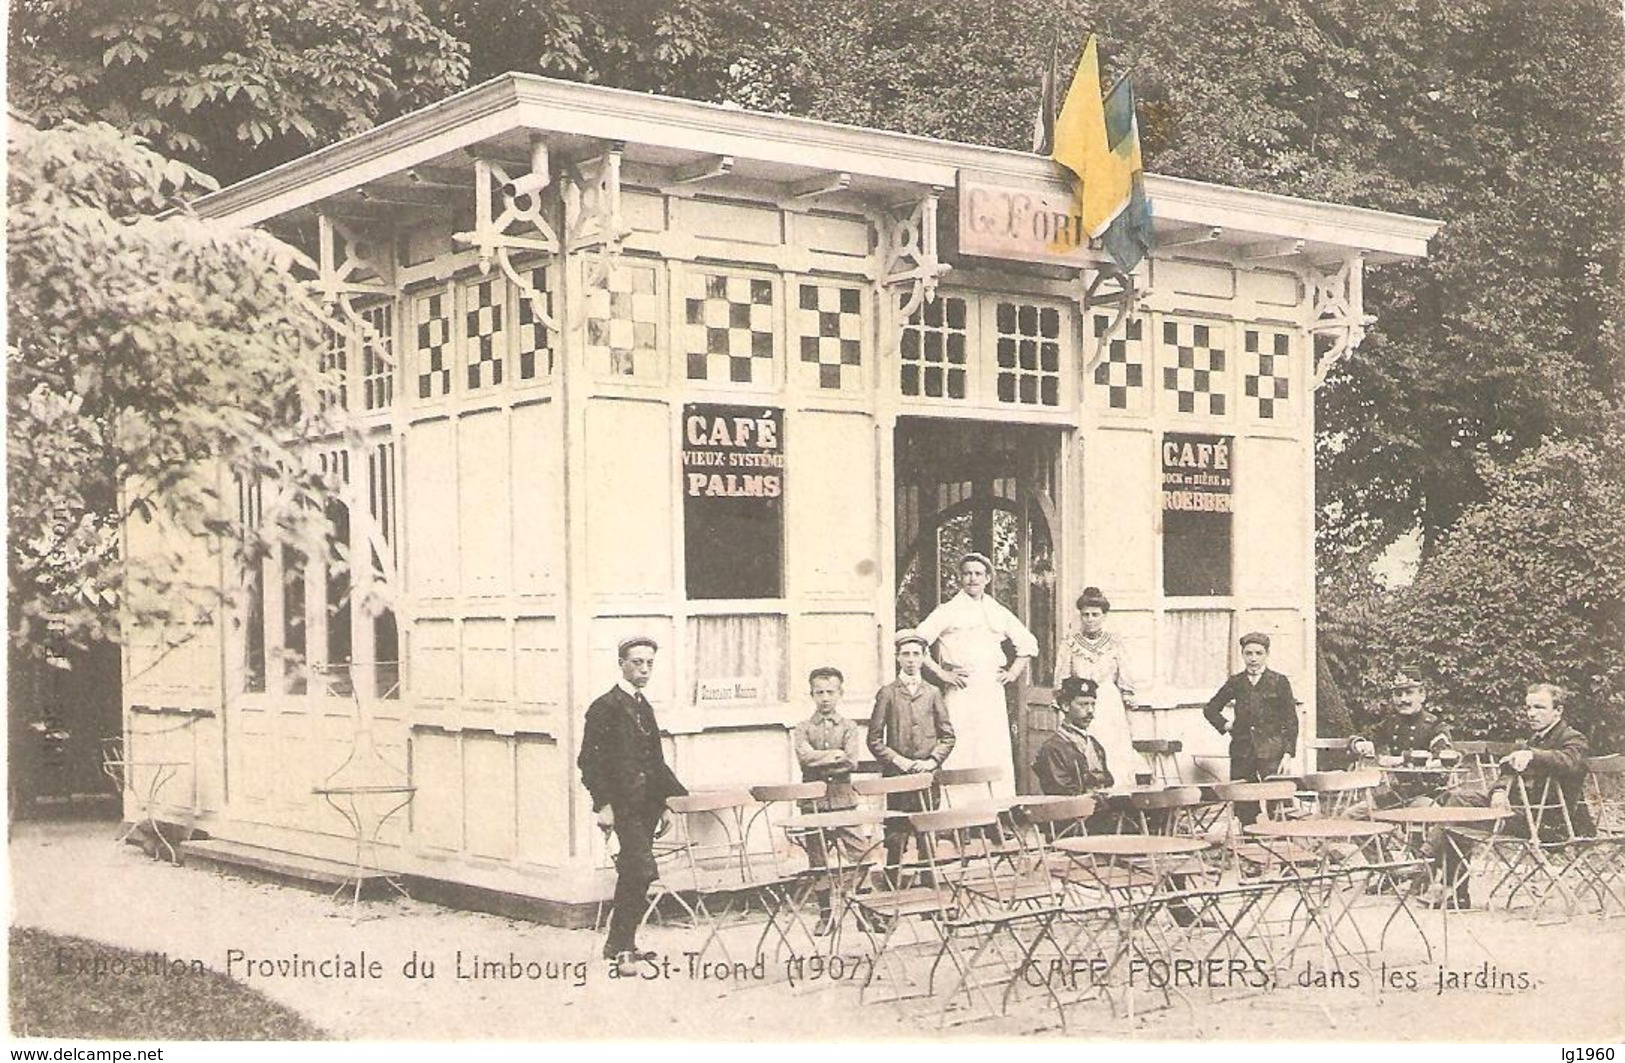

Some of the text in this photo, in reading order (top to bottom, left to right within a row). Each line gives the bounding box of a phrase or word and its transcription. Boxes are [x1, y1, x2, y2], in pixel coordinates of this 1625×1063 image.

[686, 409, 777, 449] CAFÉ
[1163, 437, 1229, 470] CAFÉ
[686, 472, 782, 498] PALMS
